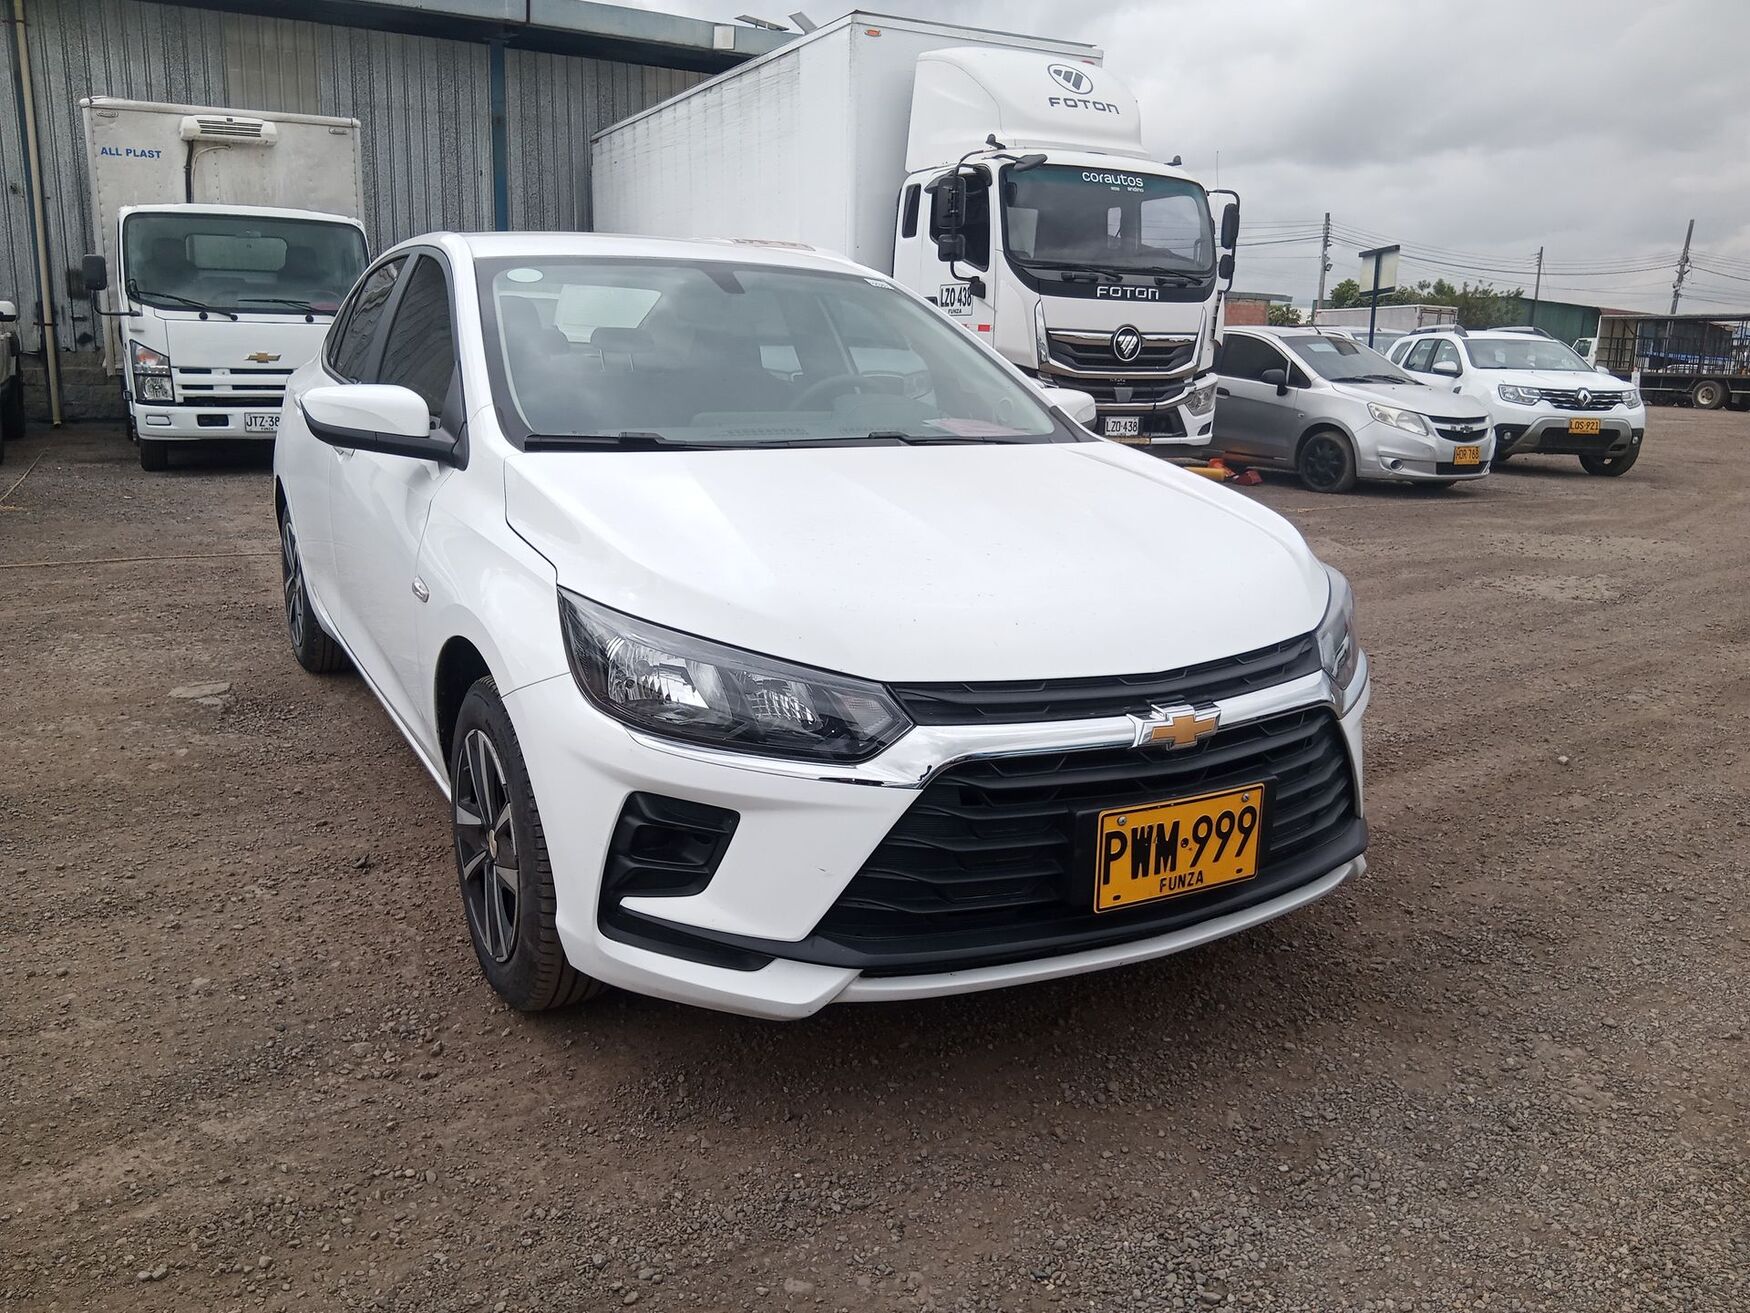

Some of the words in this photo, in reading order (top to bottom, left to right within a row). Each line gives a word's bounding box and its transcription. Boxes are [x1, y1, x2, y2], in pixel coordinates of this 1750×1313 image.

[1048, 96, 1120, 115] FOTON
[100, 146, 122, 156] ALL
[125, 148, 161, 159] PLAST
[1081, 171, 1144, 187] corautos
[940, 287, 956, 308] LZO
[956, 286, 972, 307] 438
[1096, 286, 1159, 300] FOTON
[1158, 870, 1204, 893] FUNZA
